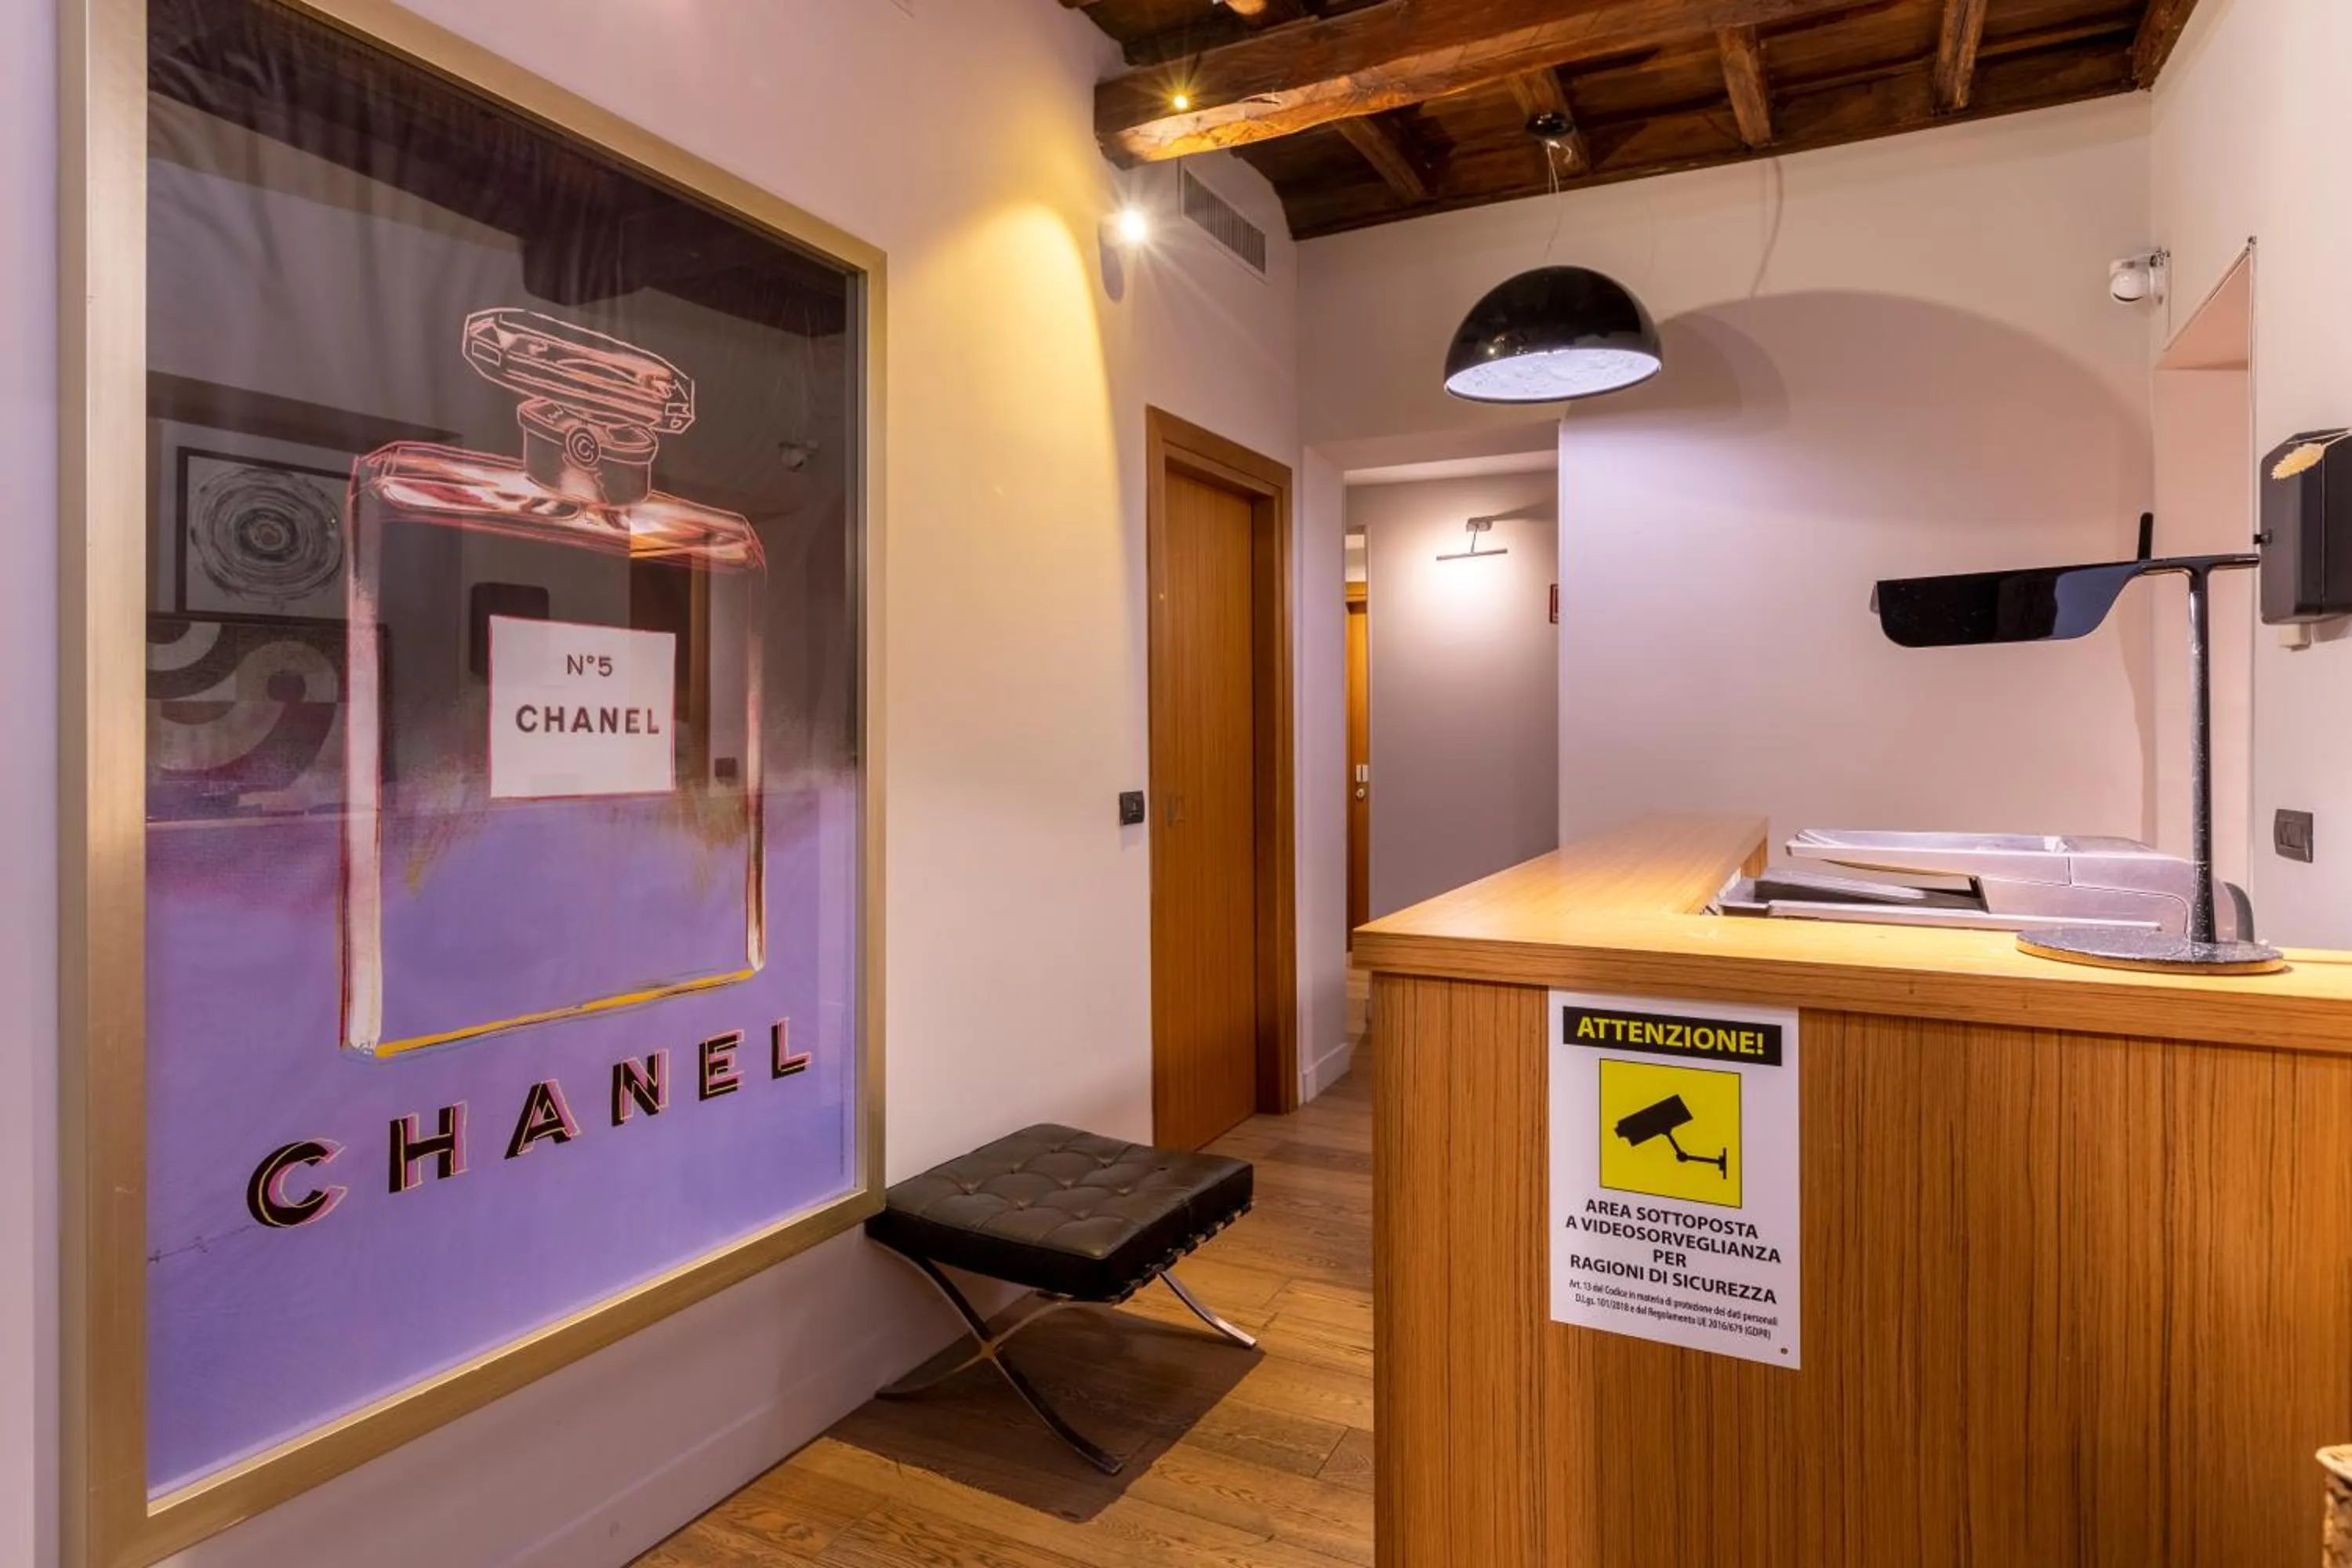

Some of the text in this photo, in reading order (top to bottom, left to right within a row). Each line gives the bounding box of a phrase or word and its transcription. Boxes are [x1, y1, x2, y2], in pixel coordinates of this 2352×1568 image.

[514, 703, 660, 735] CHANEL
[1576, 1015, 1764, 1055] ATTENZIONE!
[246, 1016, 813, 1229] CHANEL
[1566, 1214, 1781, 1264] A VIDEOSORVEGLIANZA
[1585, 1198, 1759, 1240] AREA SOTTOPOSTA
[1653, 1248, 1686, 1268] PER
[1570, 1254, 1777, 1305] RAGIONI DI SICUREZZA
[1569, 1279, 1581, 1290] Art.
[1584, 1282, 1592, 1291] 13
[1605, 1285, 1628, 1298] Codice
[1628, 1290, 1636, 1299] in
[1665, 1296, 1672, 1306] di
[1714, 1305, 1726, 1316] dei
[1727, 1308, 1741, 1319] dati
[1743, 1312, 1779, 1326] personali
[1647, 1306, 1696, 1324] Regolamento
[1708, 1318, 1743, 1334] 2016/679
